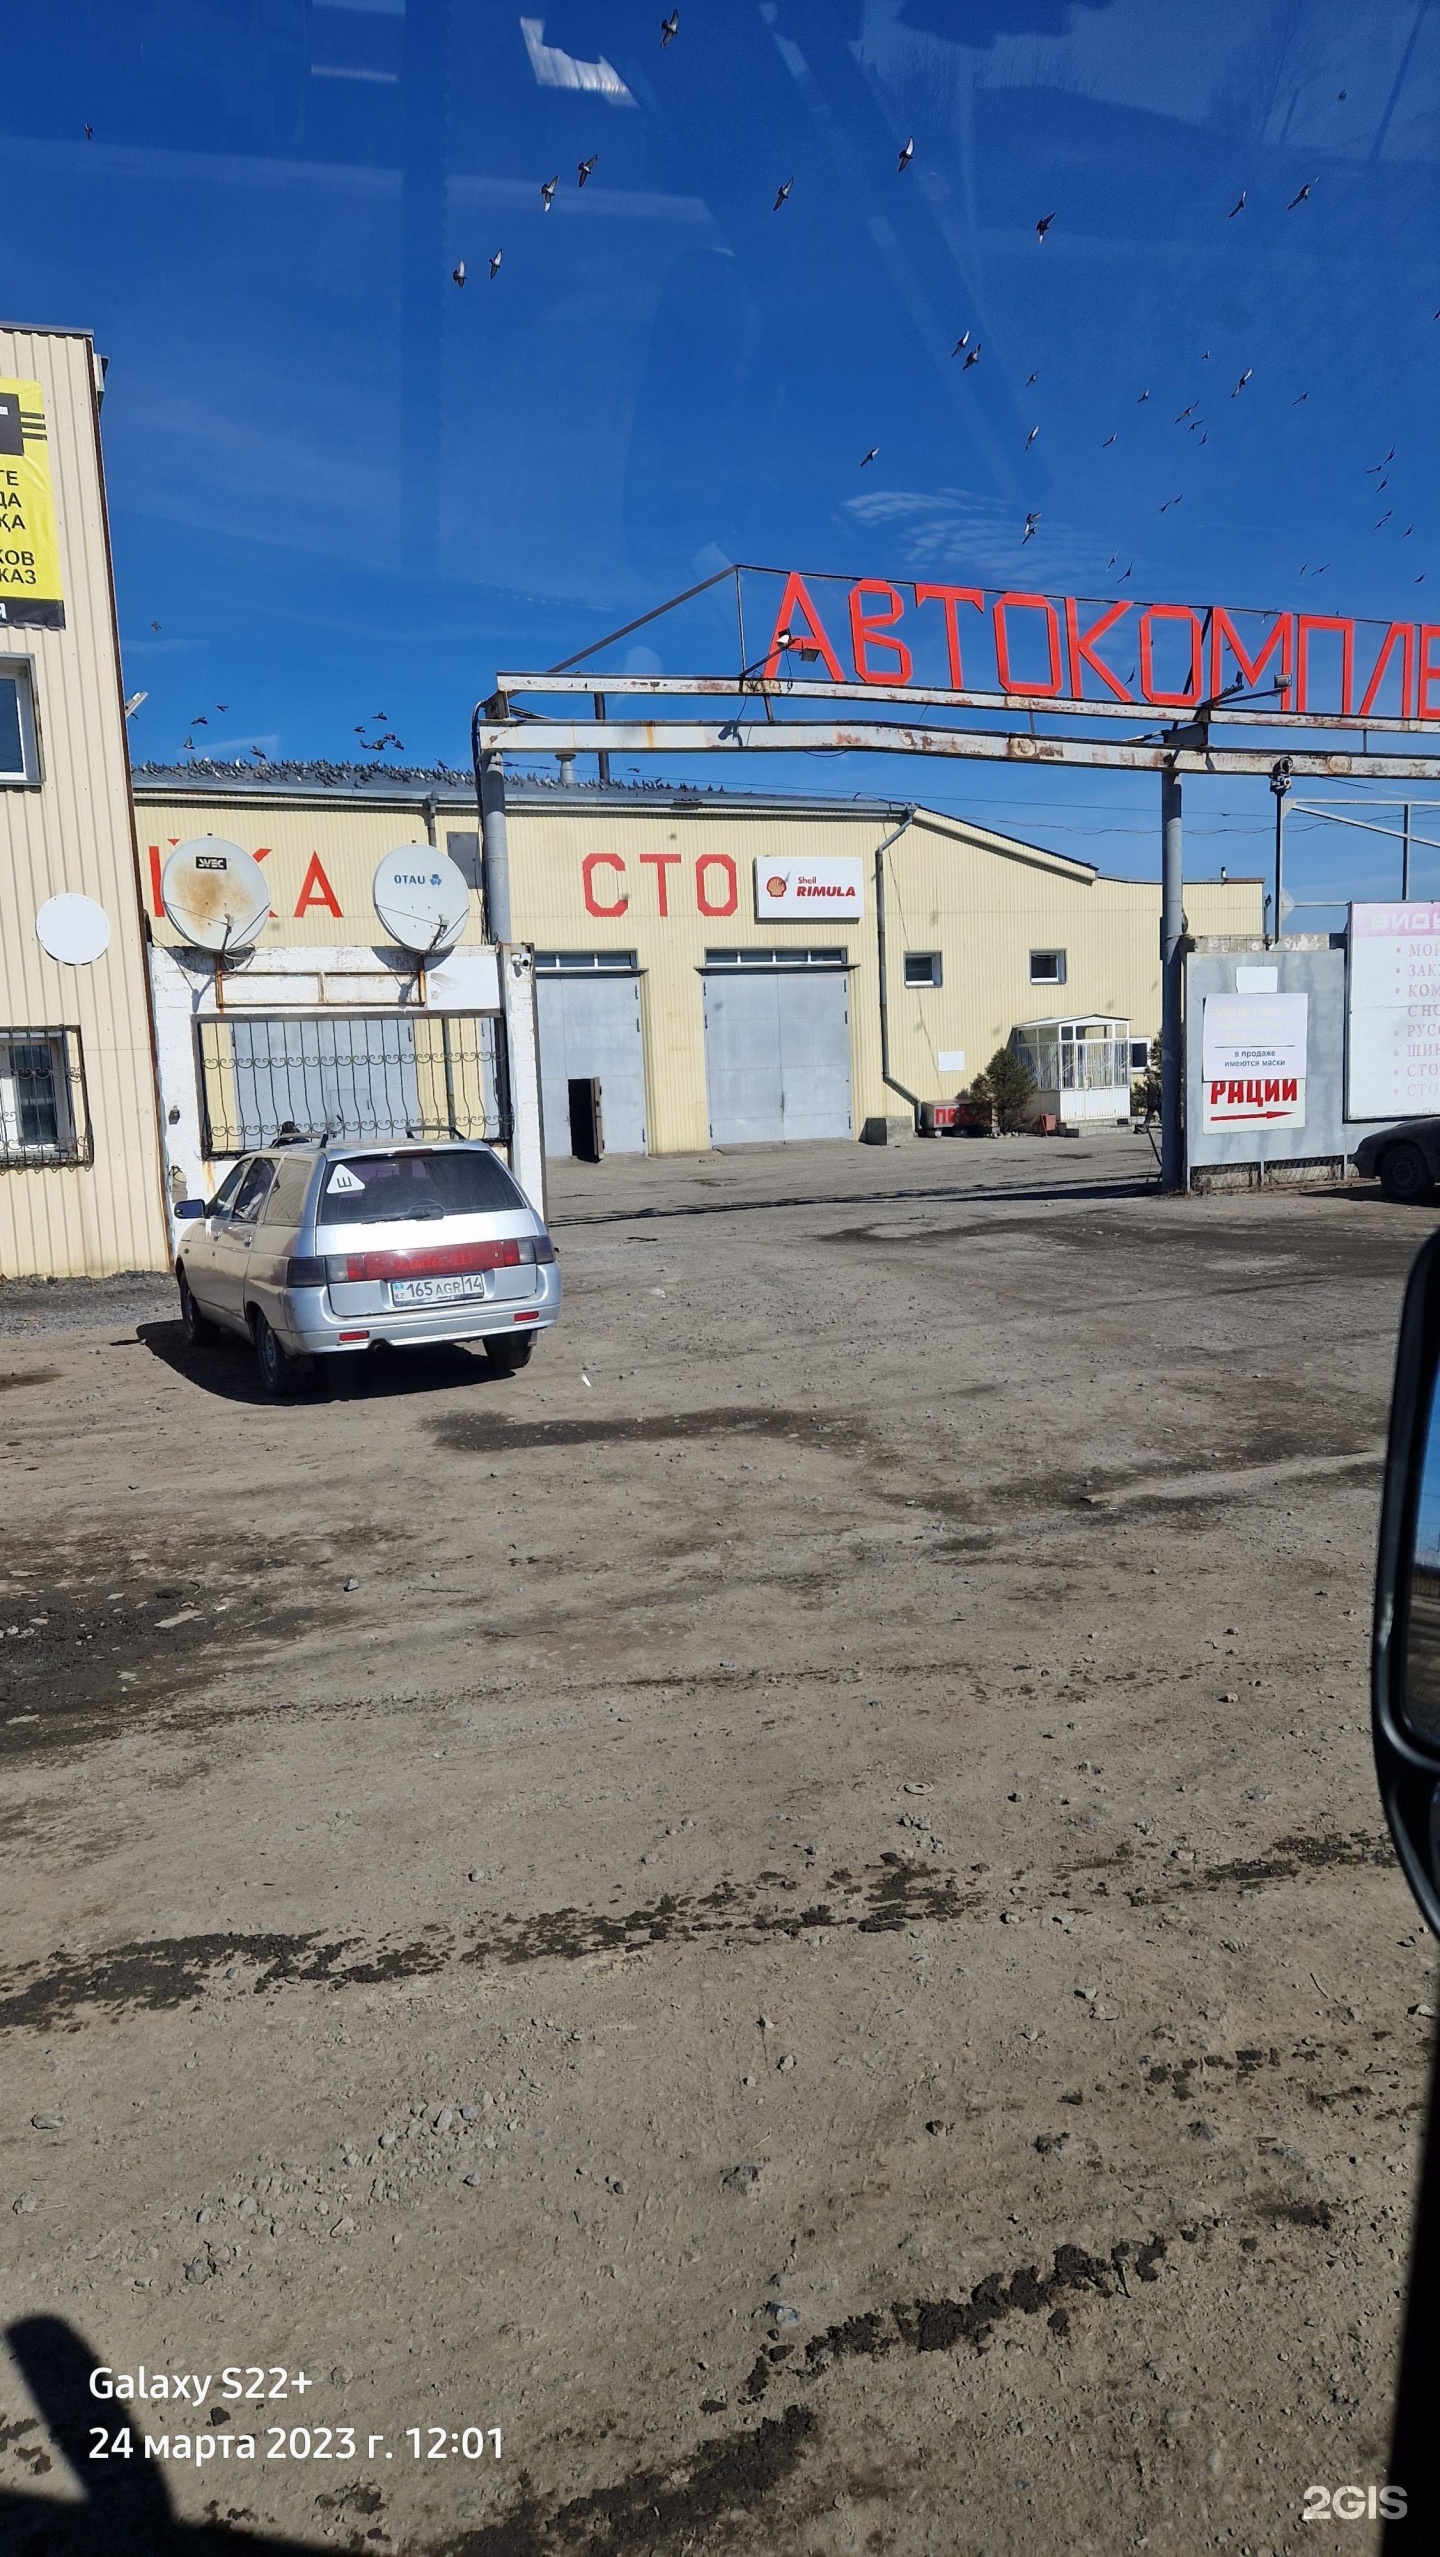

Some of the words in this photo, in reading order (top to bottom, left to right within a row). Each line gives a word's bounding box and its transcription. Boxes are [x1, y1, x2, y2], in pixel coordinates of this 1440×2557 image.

[394, 874, 426, 885] OTAU
[582, 853, 738, 917] СТО
[797, 876, 817, 885] Shell
[796, 886, 856, 897] RIMULA
[1241, 1050, 1276, 1059] продаже
[1224, 1060, 1260, 1068] имеются
[1261, 1059, 1286, 1067] маски
[1210, 1079, 1297, 1107] РАЦИИ
